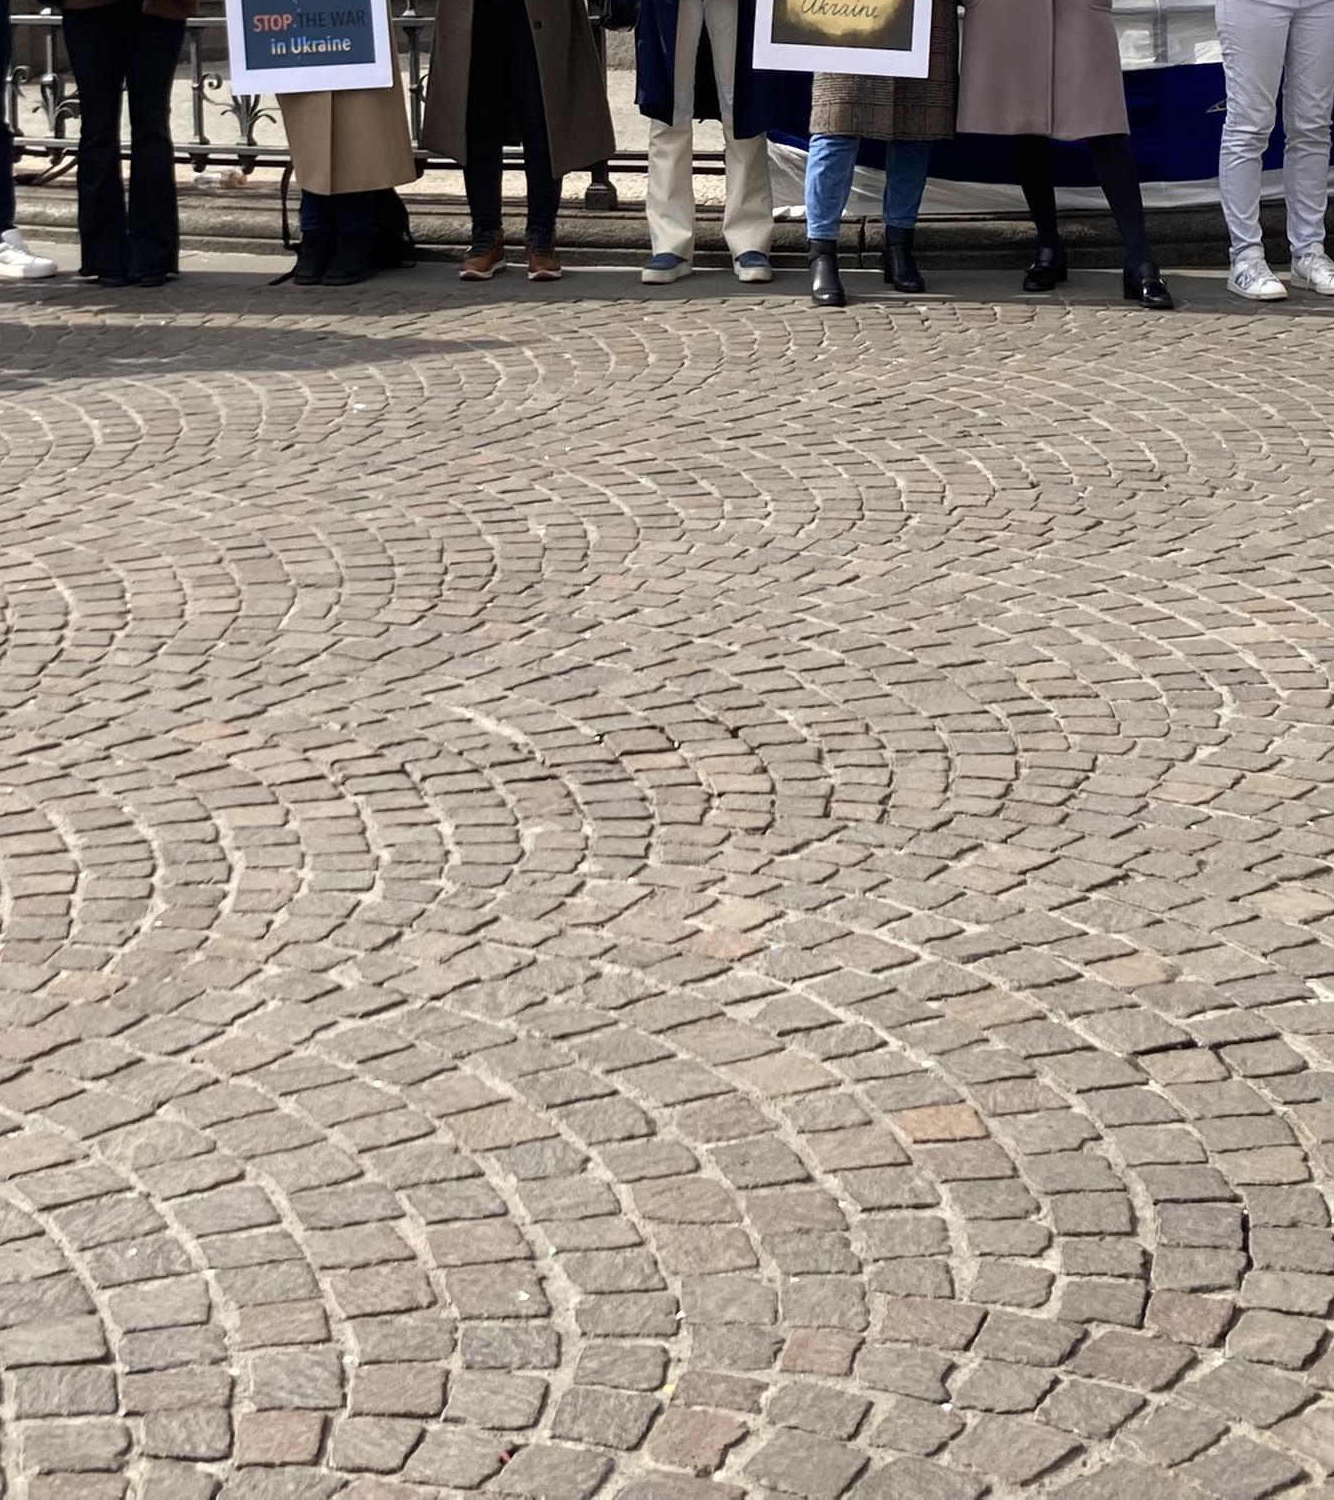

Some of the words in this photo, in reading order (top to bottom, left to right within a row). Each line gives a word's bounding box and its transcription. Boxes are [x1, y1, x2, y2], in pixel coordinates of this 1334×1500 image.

[253, 14, 293, 33] STOP
[297, 12, 327, 29] THE
[331, 10, 365, 27] WAR
[271, 38, 286, 55] in
[291, 36, 351, 54] Ukraine
